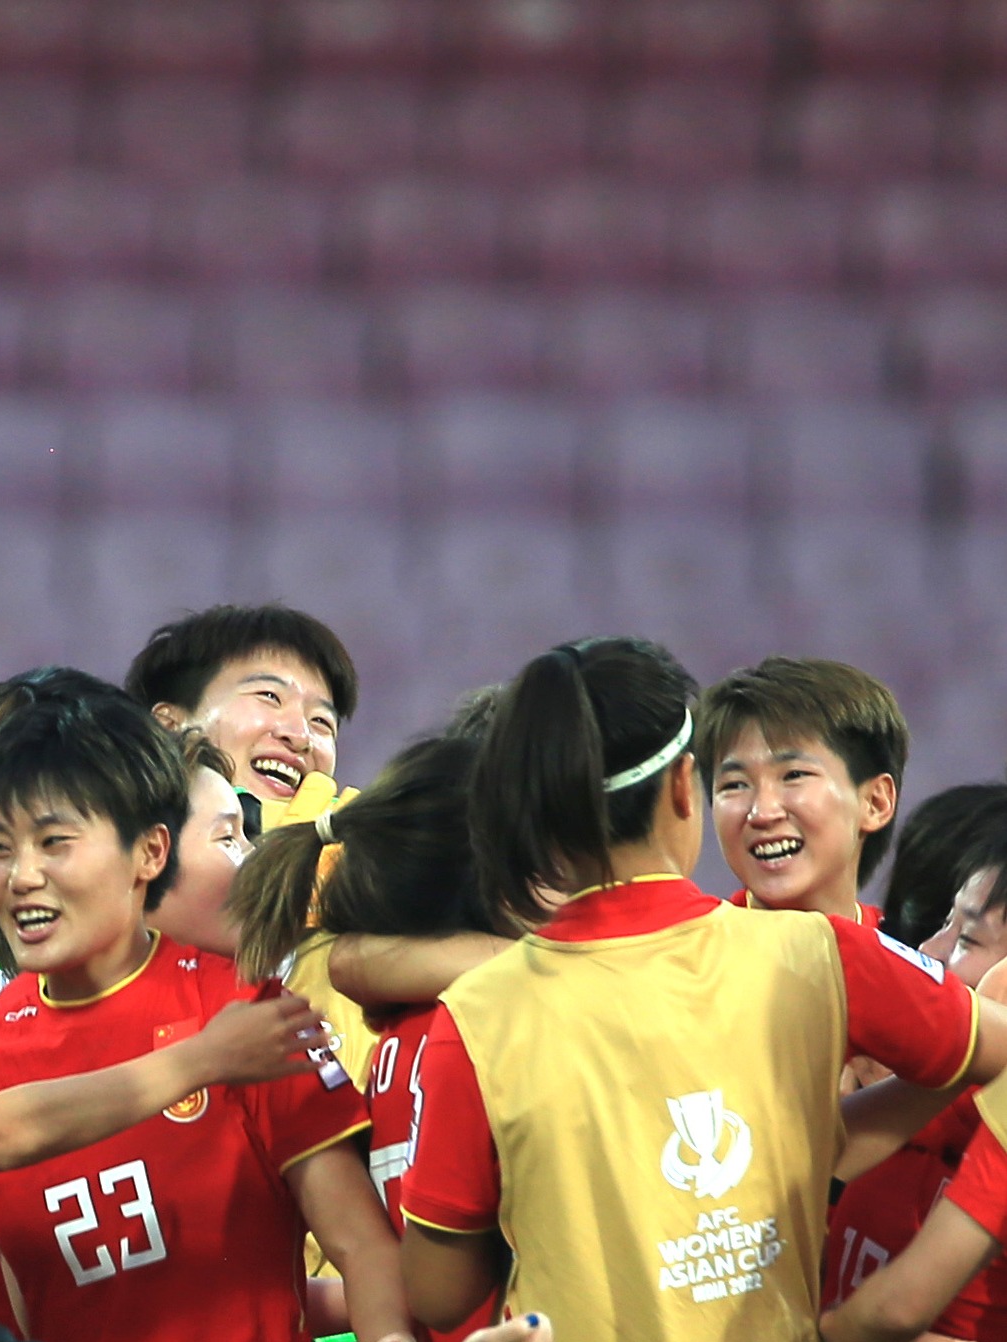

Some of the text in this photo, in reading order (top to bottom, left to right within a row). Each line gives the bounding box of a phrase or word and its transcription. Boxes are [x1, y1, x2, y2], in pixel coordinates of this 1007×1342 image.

[44, 1159, 167, 1287] 23
[657, 1217, 778, 1265] WOMEN'S
[696, 1205, 741, 1233] AFC
[658, 1240, 782, 1291] ASIAN CUP
[691, 1271, 764, 1303] INDIA 2022
